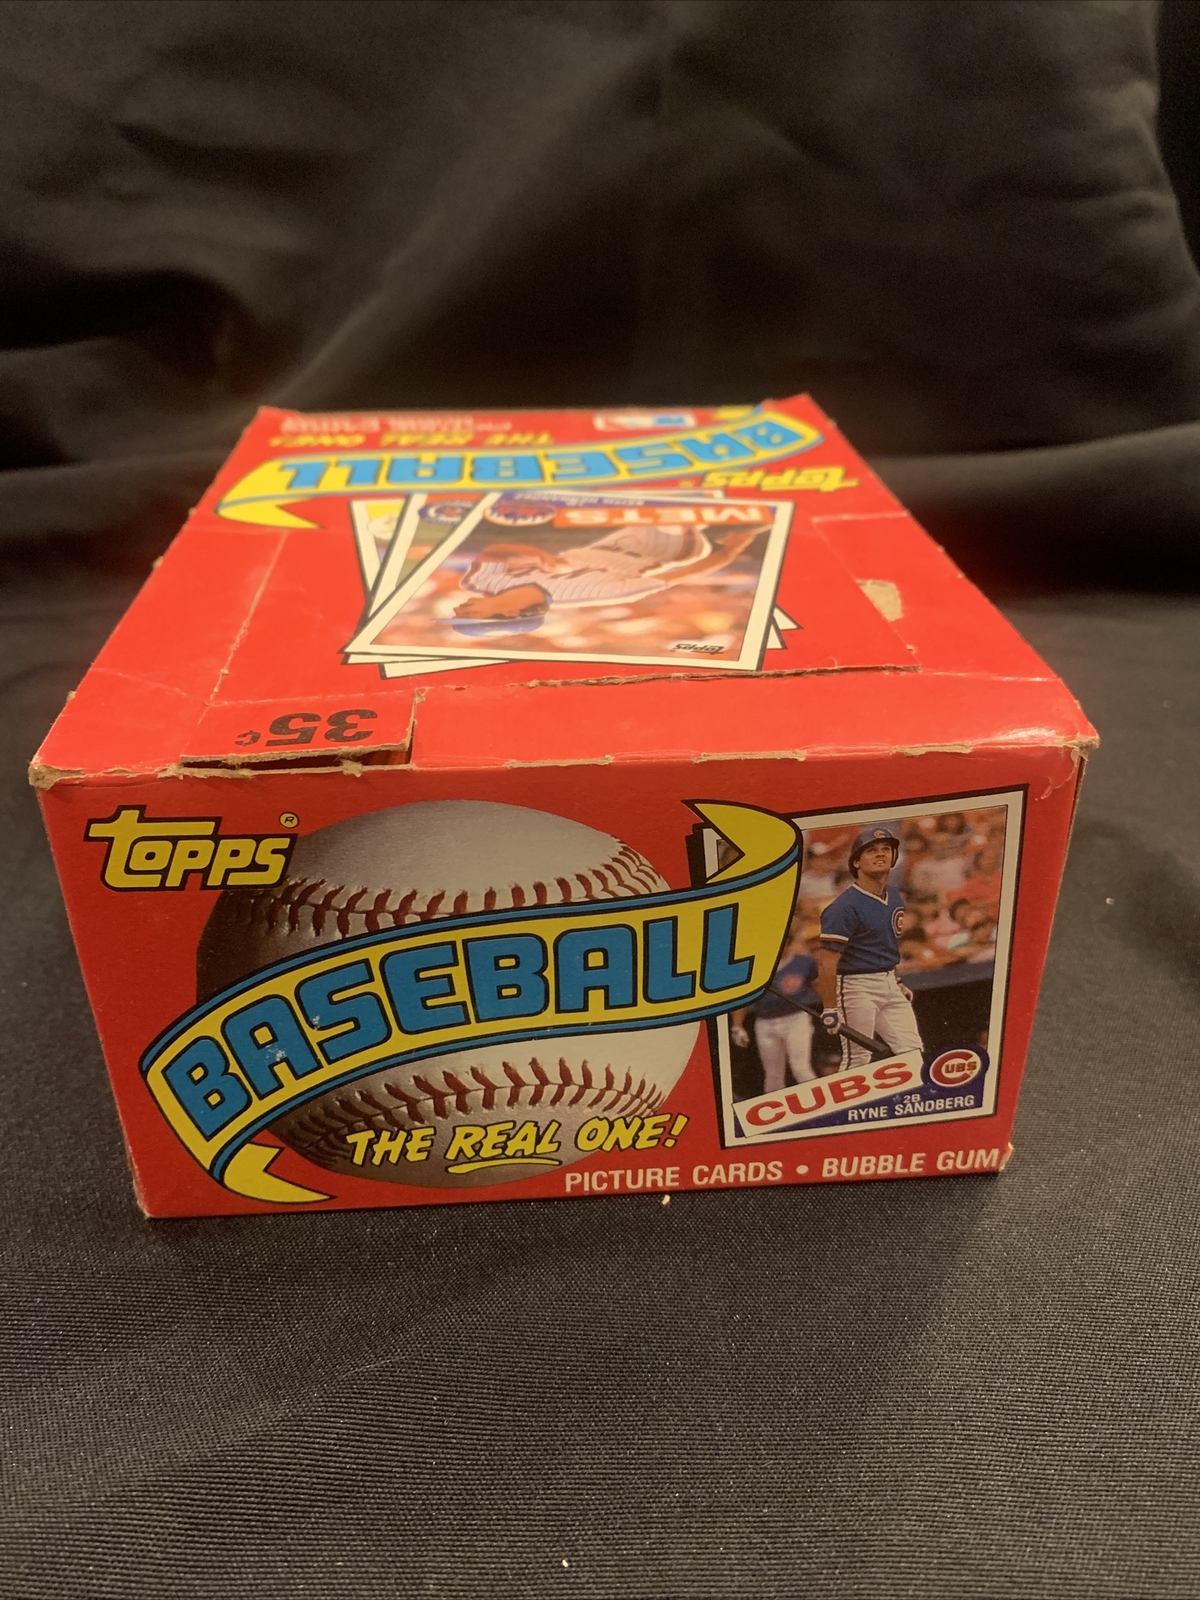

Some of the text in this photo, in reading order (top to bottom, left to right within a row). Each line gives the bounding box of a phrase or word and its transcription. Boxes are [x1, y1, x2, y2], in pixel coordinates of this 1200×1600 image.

[277, 419, 805, 490] BASEBALL
[565, 505, 763, 525] METS
[163, 903, 755, 1142] BASEBALL
[745, 1062, 914, 1127] CUBS
[847, 1095, 976, 1122] RYNE SANDBERG
[903, 1094, 921, 1104] 2B
[345, 1112, 691, 1167] THE REAL ONE!
[565, 1147, 1001, 1193] PICTURE CARDS BUBBLE GUM
